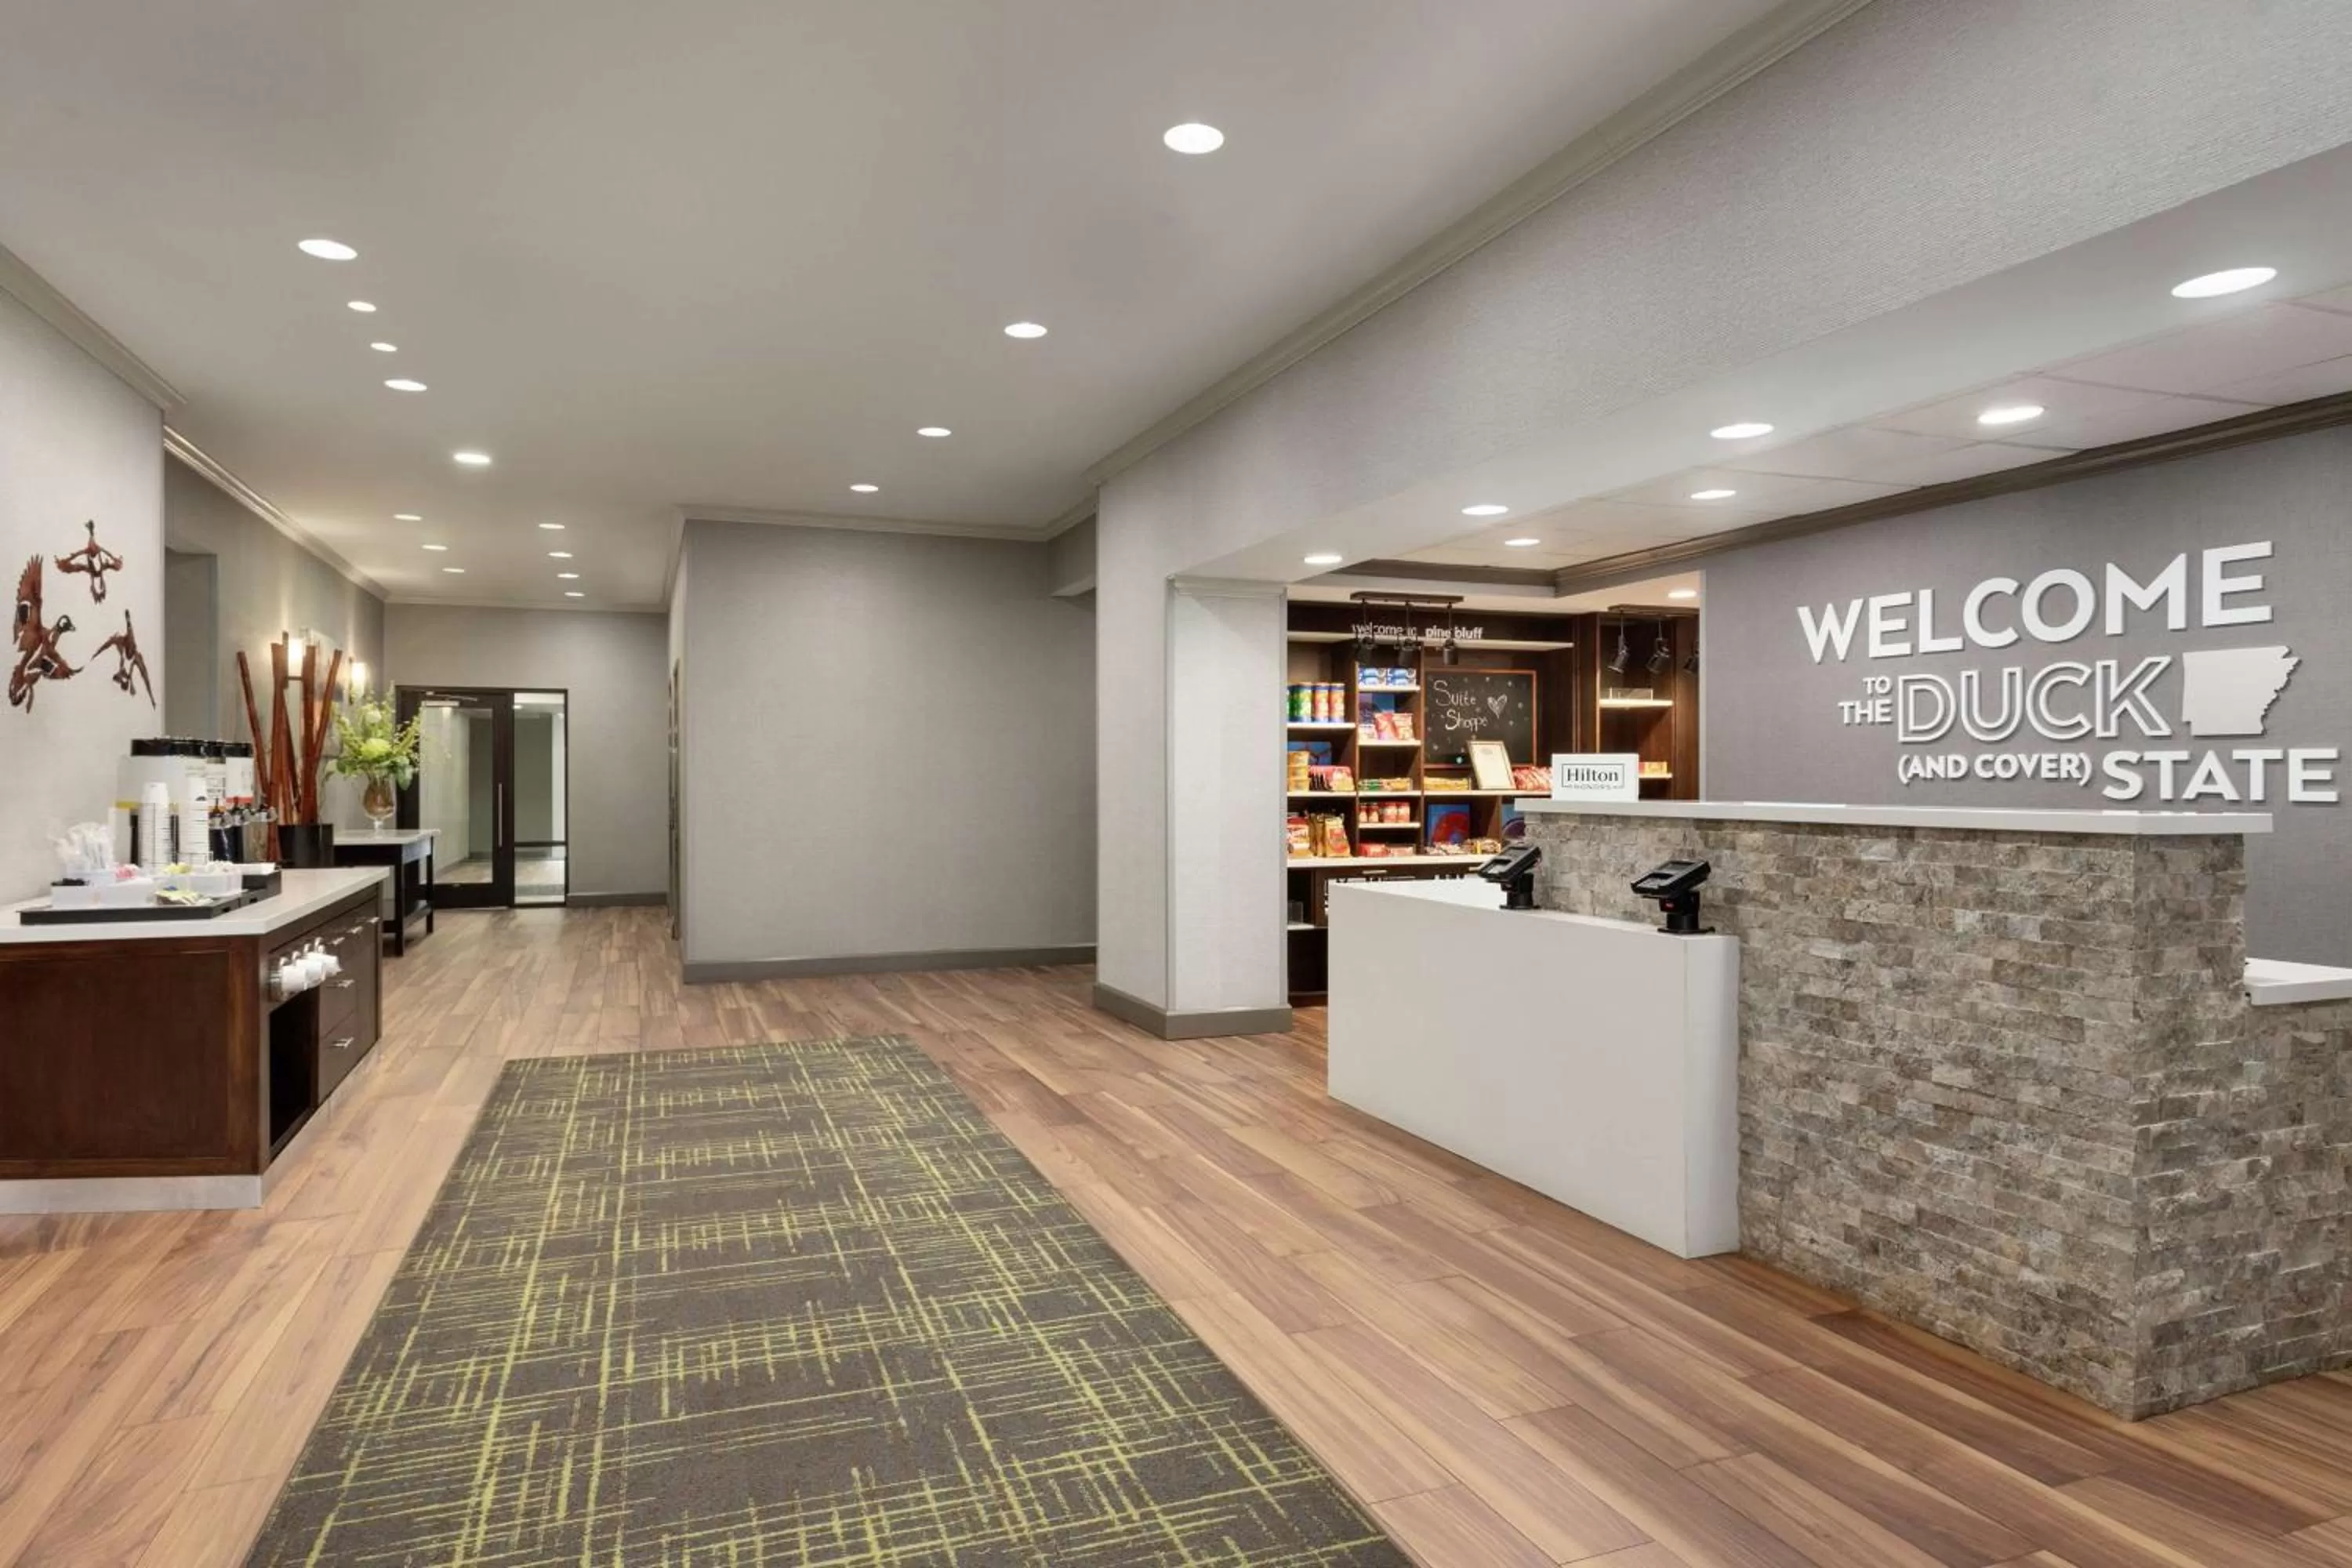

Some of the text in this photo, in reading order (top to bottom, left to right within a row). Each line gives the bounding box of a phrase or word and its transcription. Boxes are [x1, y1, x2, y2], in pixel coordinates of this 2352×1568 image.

[1797, 540, 2273, 663] WELCOME
[1425, 625, 1451, 639] pine
[1454, 626, 1483, 639] bluff
[1433, 679, 1477, 706] Suite
[1838, 654, 2172, 743] THE DUCK
[1862, 675, 1892, 695] TO
[1567, 768, 1619, 782] Hilton
[1897, 748, 2339, 803] (AND COVER) STATE
